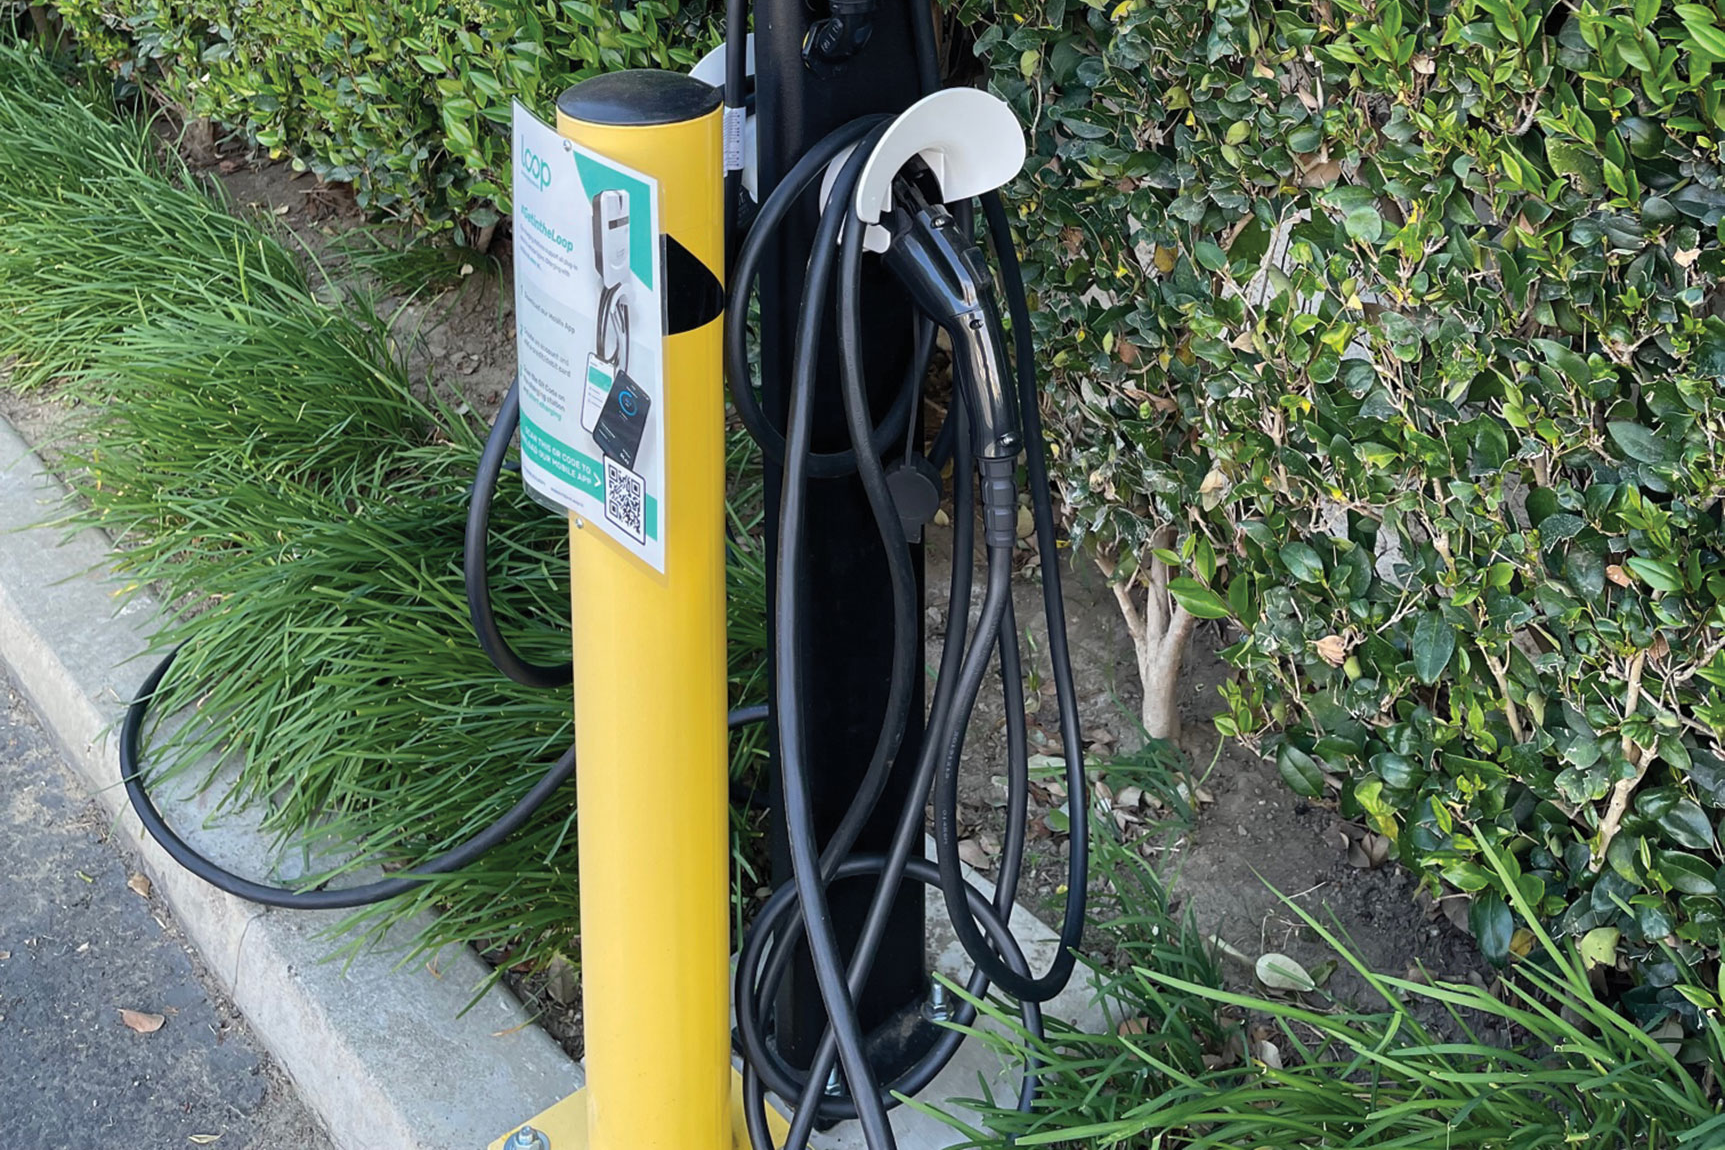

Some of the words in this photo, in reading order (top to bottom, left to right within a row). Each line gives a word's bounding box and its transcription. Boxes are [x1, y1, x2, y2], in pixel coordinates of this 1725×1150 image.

[521, 134, 551, 192] loop
[564, 322, 576, 335] App
[537, 437, 551, 453] THIS
[561, 453, 580, 469] CODE
[581, 462, 592, 475] TO
[538, 449, 552, 465] OUR
[551, 457, 577, 478] MOBILE
[576, 472, 592, 485] APP
